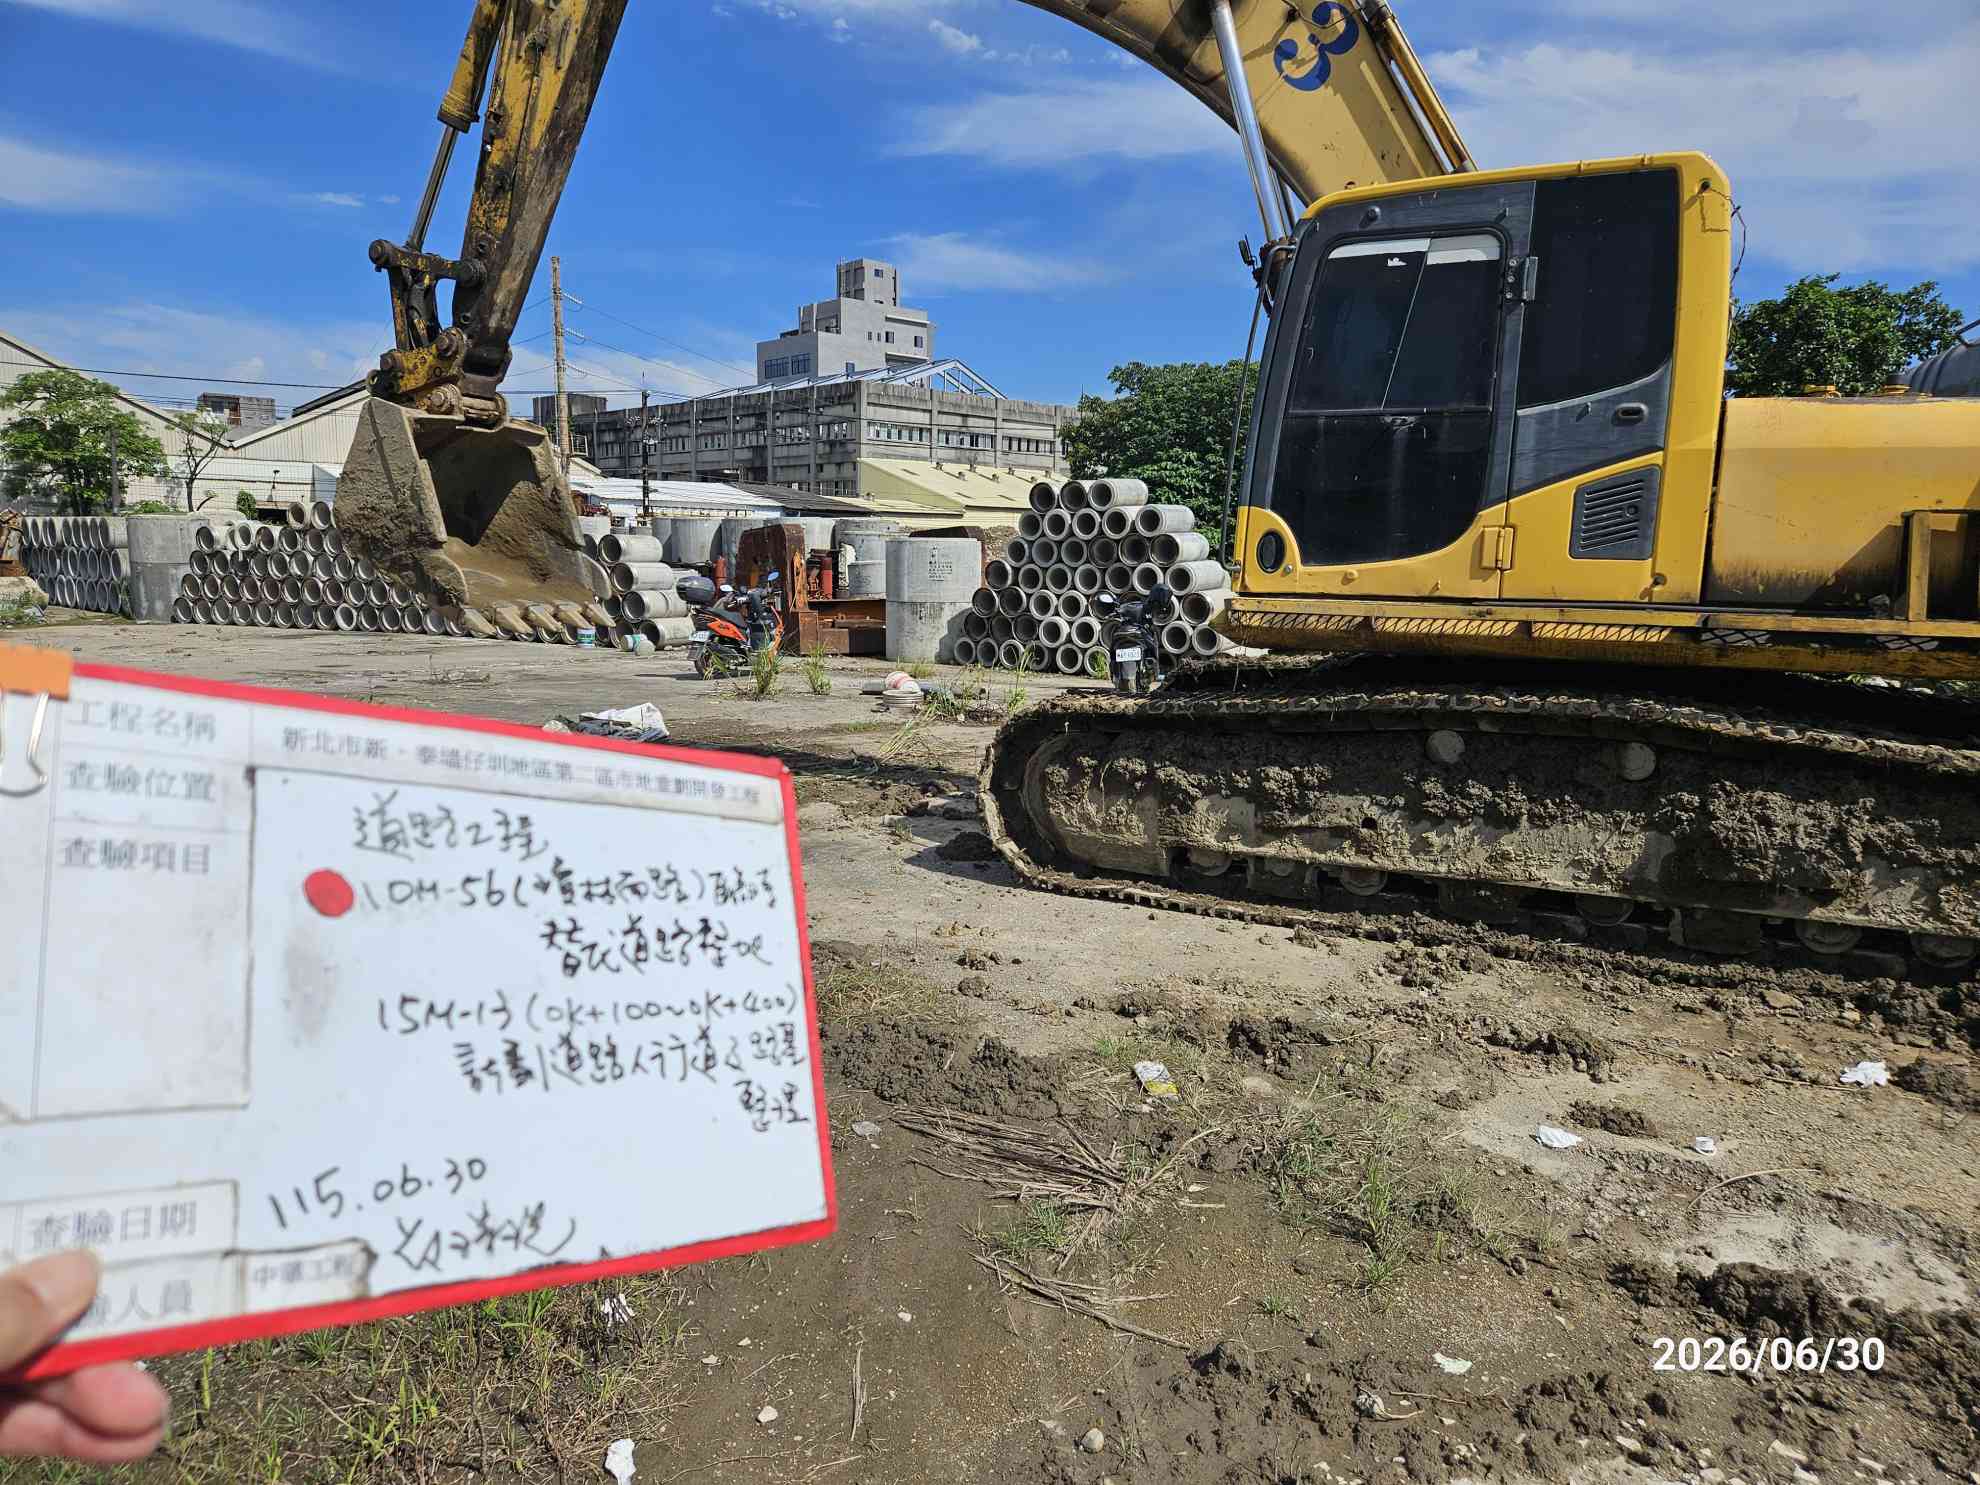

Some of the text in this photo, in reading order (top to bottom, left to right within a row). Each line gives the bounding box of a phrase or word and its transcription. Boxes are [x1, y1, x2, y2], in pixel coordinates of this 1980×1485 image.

[68, 702, 216, 743] 工程名稱
[65, 760, 216, 803] 查驗位置
[61, 837, 212, 875] 查驗項目
[268, 1158, 487, 1230] 115.06.30
[32, 1201, 197, 1249] 查驗日期
